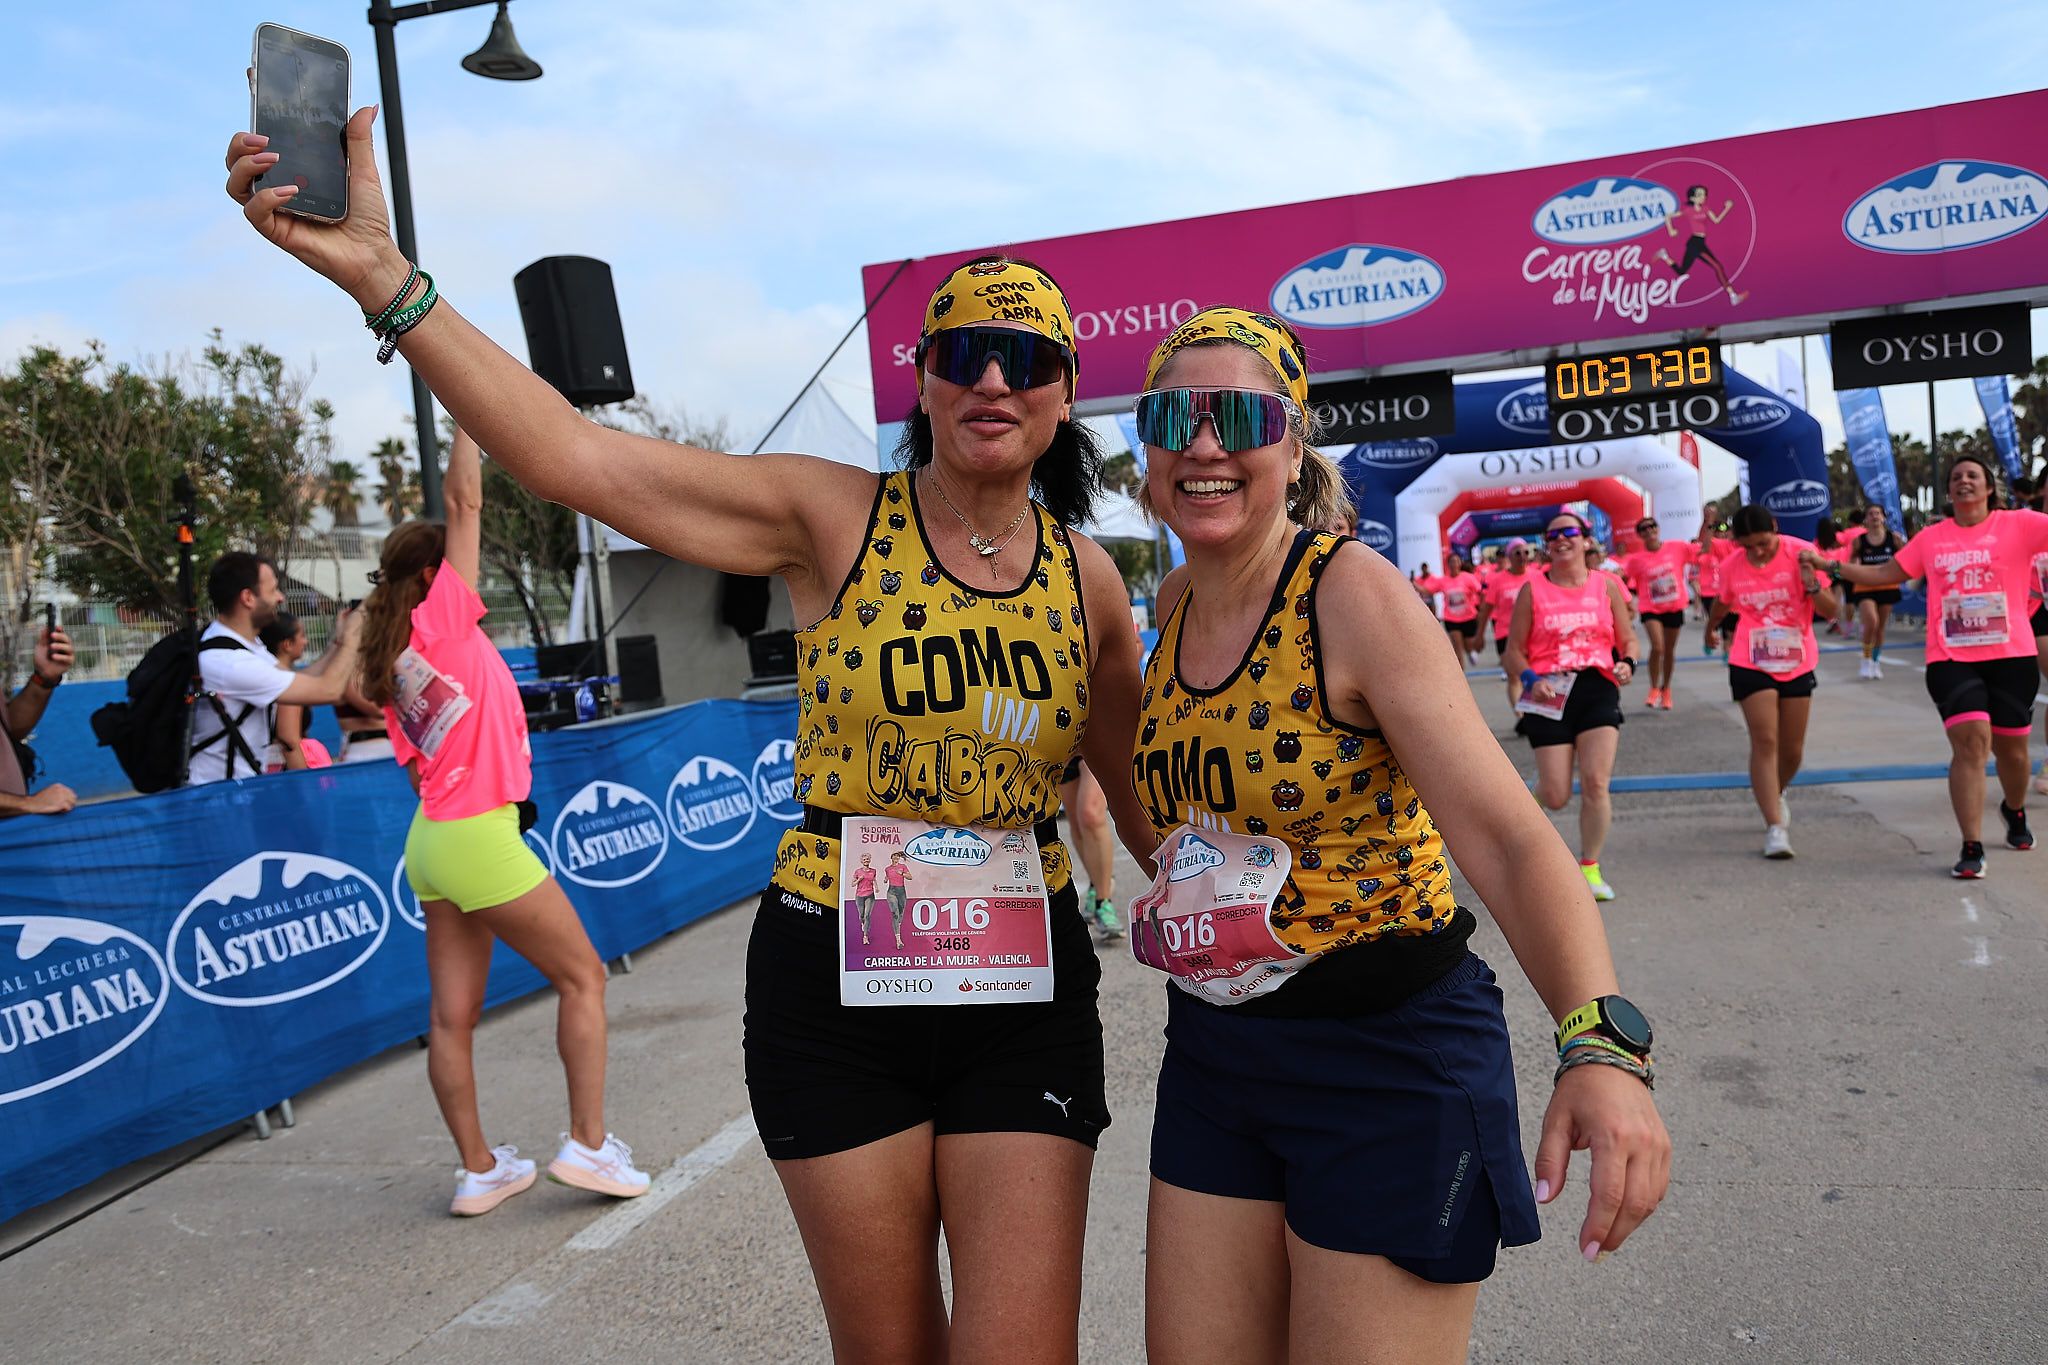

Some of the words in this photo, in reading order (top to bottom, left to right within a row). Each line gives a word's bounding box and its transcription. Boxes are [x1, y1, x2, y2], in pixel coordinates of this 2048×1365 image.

[1890, 192, 1955, 208] CENTRAL
[1962, 181, 2031, 198] LECHERA
[1545, 202, 1667, 234] ASTURIANA
[1861, 194, 2039, 237] ASTURIANA
[1522, 245, 1643, 283] Carrera
[974, 281, 1036, 297] COMO
[986, 291, 1030, 308] UNA
[1285, 276, 1432, 313] ASTURIANA
[1552, 279, 1577, 305] de
[1580, 278, 1597, 302] la
[1594, 266, 1690, 324] Mujer
[992, 305, 1045, 324] CABRA
[1074, 298, 1200, 341] OYSHO
[1862, 328, 2004, 366] OYSHO
[1556, 346, 1713, 400] 00:37:38
[1316, 394, 1431, 429] OYSHO
[1557, 395, 1720, 440] OYSHO
[1480, 444, 1601, 478] OYSHO
[941, 590, 982, 613] CAB
[991, 599, 1019, 615] LOCA
[880, 626, 1054, 717] COMO
[980, 690, 1042, 747] UNA
[1200, 708, 1221, 721] LOCA
[819, 746, 839, 758] LOCA
[867, 716, 1056, 824] CABRA
[1130, 735, 1238, 830] COMO
[675, 791, 752, 835] ASTURIANA
[871, 826, 901, 834] DORSAL
[1283, 810, 1325, 832] COMO
[565, 819, 663, 872] ASTURIANA
[861, 833, 901, 845] SUMA
[912, 843, 986, 860] ASTURIANA
[794, 864, 816, 882] LOCA
[1327, 836, 1388, 882] CABRA
[218, 901, 293, 931] CENTRAL
[297, 882, 362, 910] LECHERA
[911, 898, 990, 931] 016
[195, 899, 380, 989] ASTURIANA
[933, 937, 970, 951] 3468
[1162, 912, 1216, 952] 016
[34, 946, 130, 985] LECHERA
[864, 956, 911, 968] CARRERA
[914, 956, 928, 967] DE
[930, 955, 944, 966] LA
[946, 955, 979, 965] MUJER
[988, 954, 1032, 965] VALENCIA
[1183, 953, 1214, 968] 3469
[866, 978, 933, 993] OYSHO
[975, 979, 1033, 992] Santander
[1438, 1181, 1461, 1227] MINUTE
